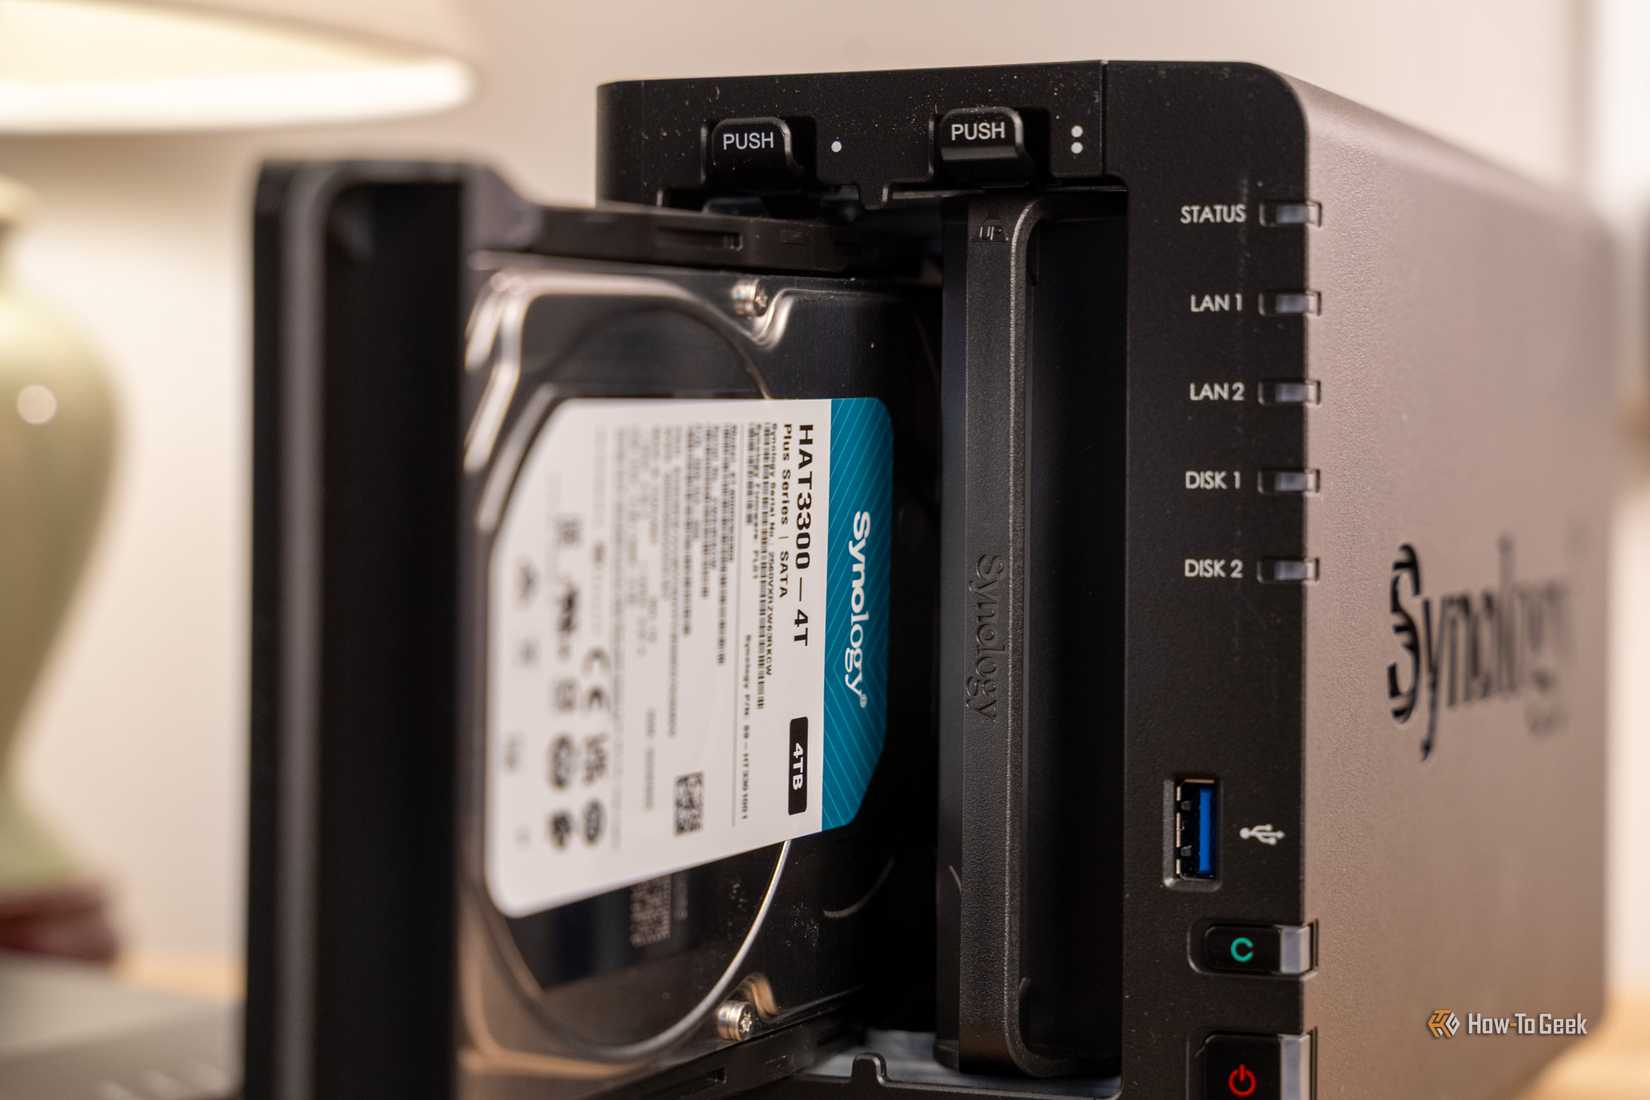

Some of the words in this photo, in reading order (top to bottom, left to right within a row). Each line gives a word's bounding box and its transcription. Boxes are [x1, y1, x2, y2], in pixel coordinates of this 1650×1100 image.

[722, 131, 774, 151] PUSH
[951, 120, 1006, 142] PUSH
[1180, 203, 1247, 225] STATUS
[1189, 294, 1230, 313] LAN
[1234, 293, 1243, 311] 1
[1189, 383, 1229, 402] LAN
[1232, 382, 1245, 400] 2
[783, 423, 792, 461] Plus
[1185, 471, 1228, 490] DISK
[1232, 471, 1242, 489] 1
[780, 469, 791, 525] Series
[779, 551, 789, 598] SATA
[1184, 559, 1226, 578] DISK
[1230, 559, 1243, 577] 2
[966, 552, 1007, 723] Synology
[792, 742, 804, 791] 4TB
